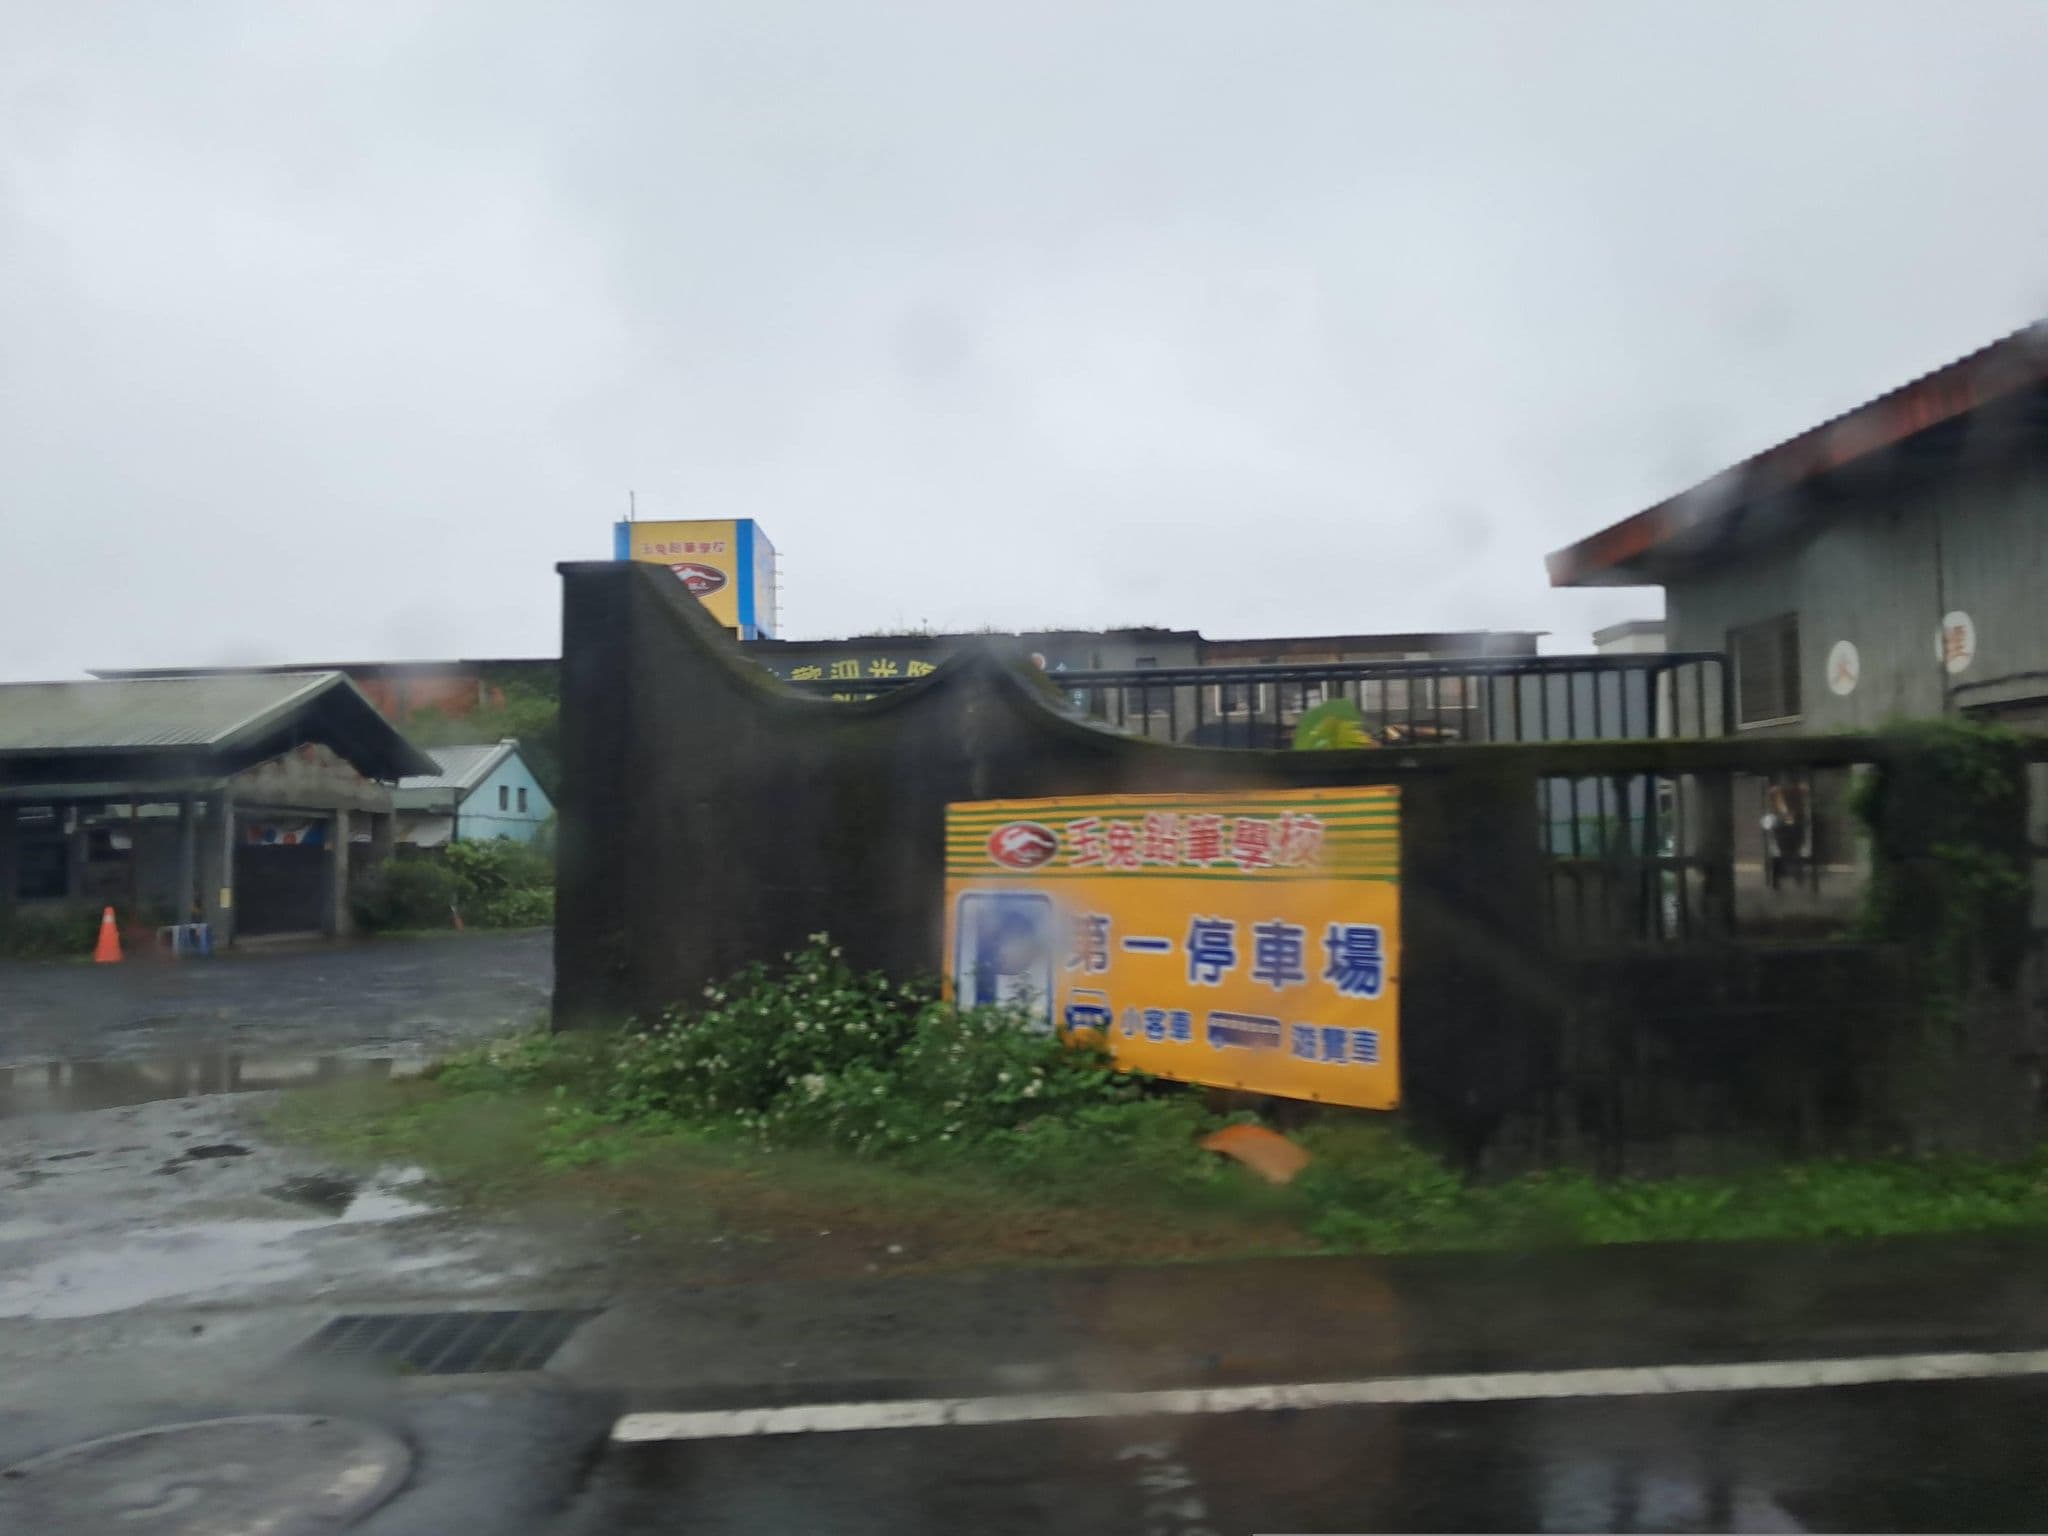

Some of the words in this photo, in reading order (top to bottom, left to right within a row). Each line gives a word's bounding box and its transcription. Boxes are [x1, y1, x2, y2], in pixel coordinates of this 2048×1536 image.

[1067, 813, 1325, 871] 玉兔鉛筆學校
[1067, 915, 1382, 997] 第一停車場
